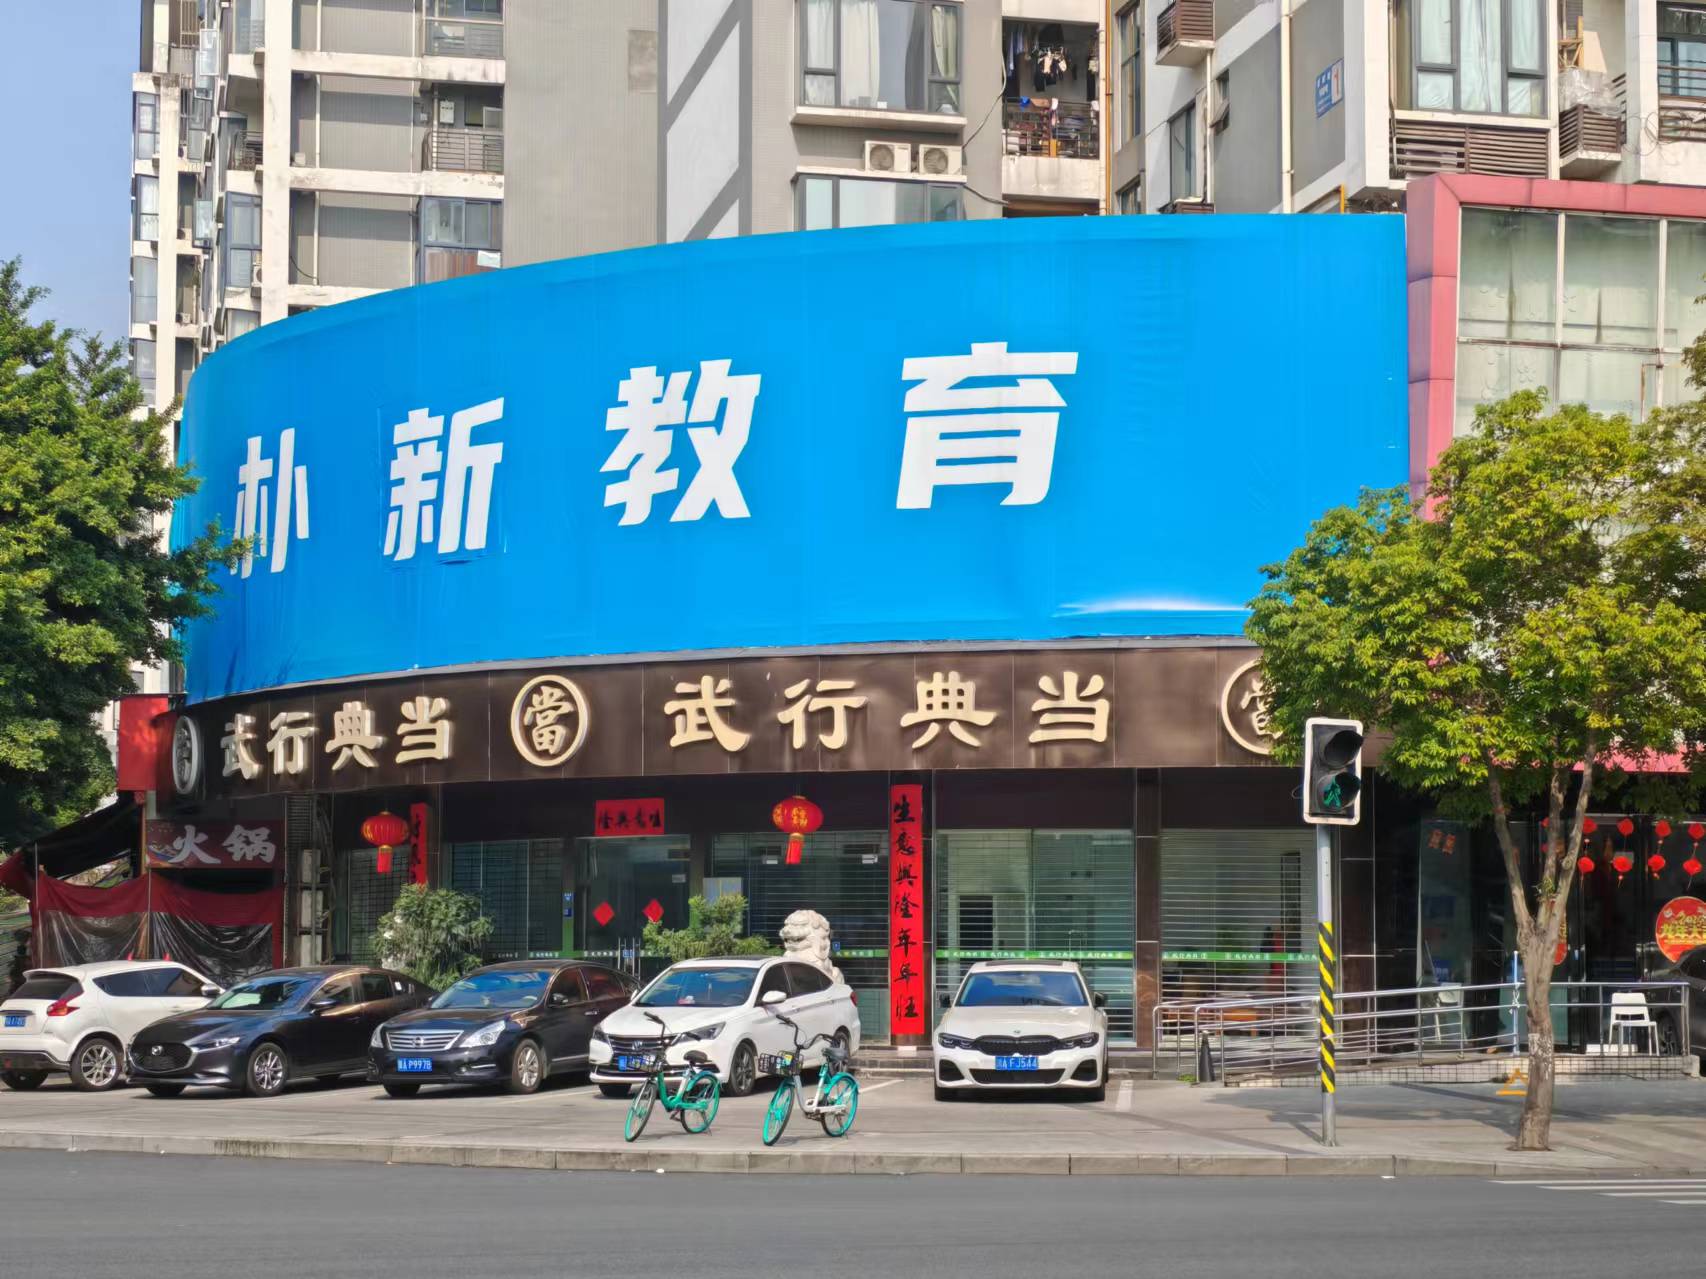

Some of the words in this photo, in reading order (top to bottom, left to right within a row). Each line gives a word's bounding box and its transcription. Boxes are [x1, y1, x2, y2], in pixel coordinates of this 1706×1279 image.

[229, 341, 1079, 580] 朴新教育
[220, 696, 453, 780] 武行典当
[520, 683, 577, 757] 當
[663, 671, 1111, 753] 武行典当
[168, 824, 276, 864] 火锅
